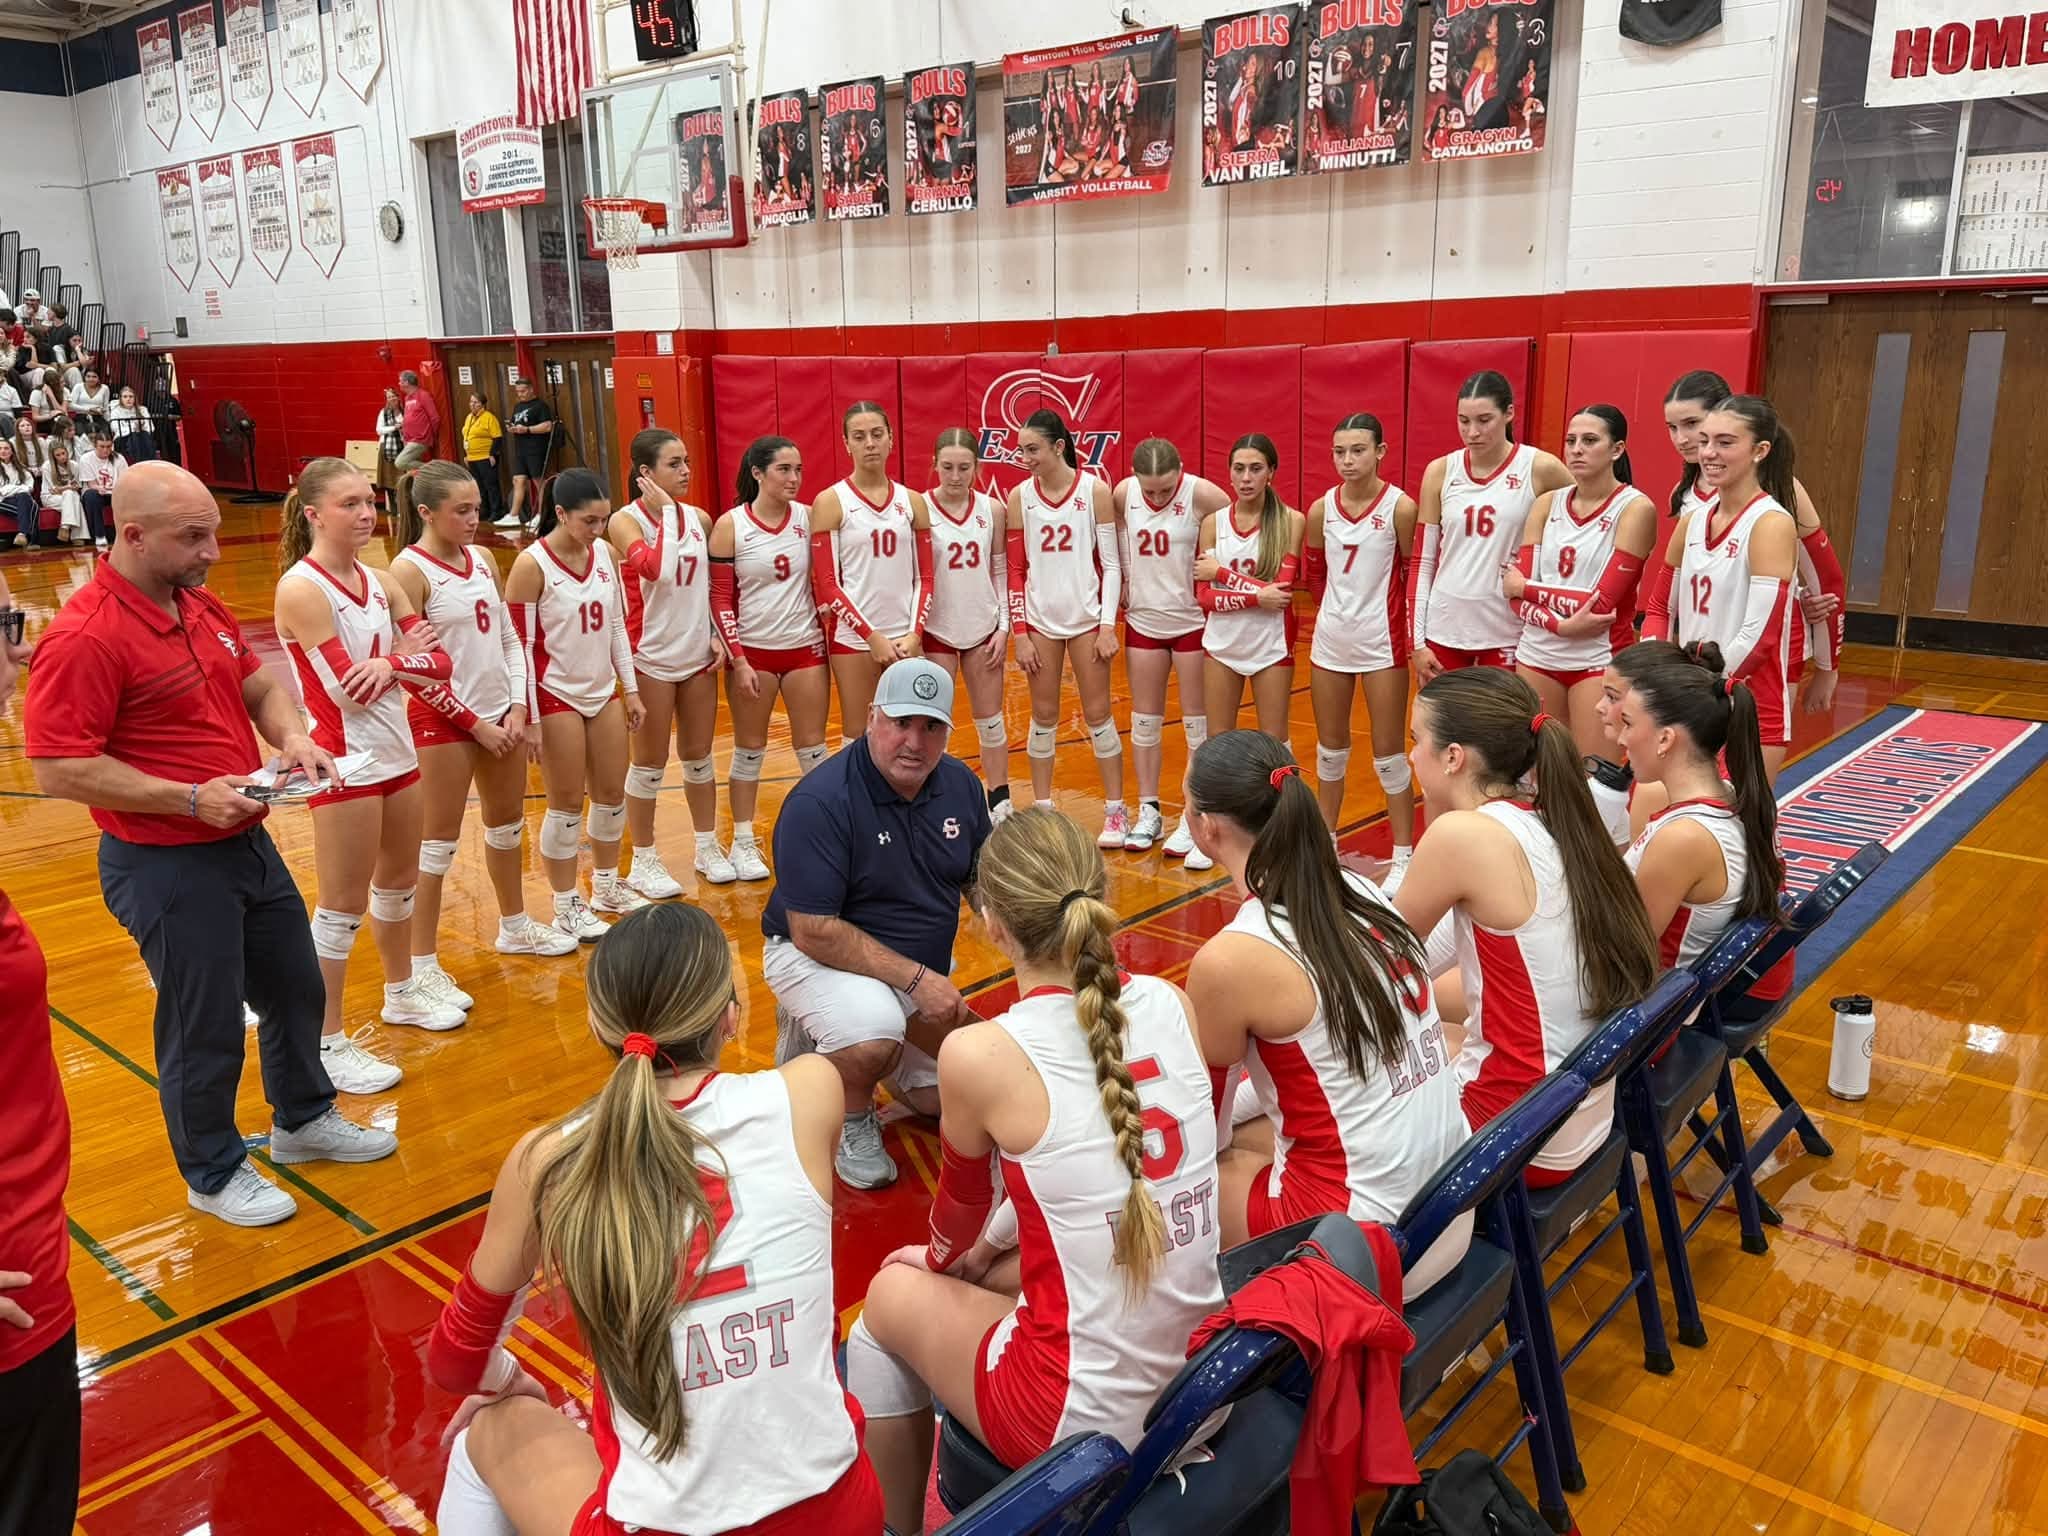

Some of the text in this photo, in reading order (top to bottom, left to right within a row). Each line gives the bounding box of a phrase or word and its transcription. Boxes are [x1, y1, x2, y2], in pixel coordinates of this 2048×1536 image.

[635, 0, 675, 46] 45
[1320, 0, 1404, 39] BULLS
[1528, 18, 1545, 46] 3
[1214, 14, 1290, 58] BULLS
[1396, 41, 1412, 70] 7
[1274, 60, 1296, 81] 10
[911, 67, 967, 104] BULLS
[825, 84, 876, 118] BULLS
[460, 115, 514, 147] SMITHTOWN
[870, 117, 881, 138] 6
[1451, 126, 1517, 145] GRACYN
[796, 133, 806, 151] 8
[1323, 134, 1395, 154] LILLIANNA
[1431, 138, 1533, 159] CATALANOTTO
[1209, 160, 1290, 183] VAN RIEL
[1219, 149, 1280, 167] SIERRA
[1319, 149, 1396, 170] MINIUTTI
[838, 191, 873, 206] SADIE
[911, 196, 973, 213] CERULLO
[914, 183, 970, 201] BRIANNA
[1033, 180, 1153, 201] VARSITY VOLLEYBALL
[762, 210, 809, 225] INGOGLIA
[828, 203, 883, 219] LAPRESTI
[977, 427, 1120, 468] ET
[1463, 504, 1496, 538] 16
[870, 529, 897, 557] 10
[1040, 524, 1073, 552] 22
[1136, 529, 1170, 557] 20
[773, 554, 791, 582] 9
[947, 541, 980, 569] 23
[1342, 544, 1359, 574] 7
[1558, 545, 1577, 579] 8
[675, 556, 698, 587] 17
[1010, 590, 1025, 624] EAST
[1215, 596, 1246, 612] EAST
[1538, 590, 1578, 616] EAST
[1690, 572, 1712, 616] 12
[474, 599, 491, 634] 6
[578, 600, 604, 634] 19
[719, 610, 740, 644] EAST
[830, 597, 862, 631] EAST
[1519, 600, 1549, 628] EAST
[400, 652, 437, 670] EAST
[418, 683, 464, 720] EAST
[1382, 1020, 1450, 1098] EAST
[1126, 1052, 1190, 1188] 5
[1106, 1177, 1213, 1265] ST
[682, 1298, 794, 1391] AST
